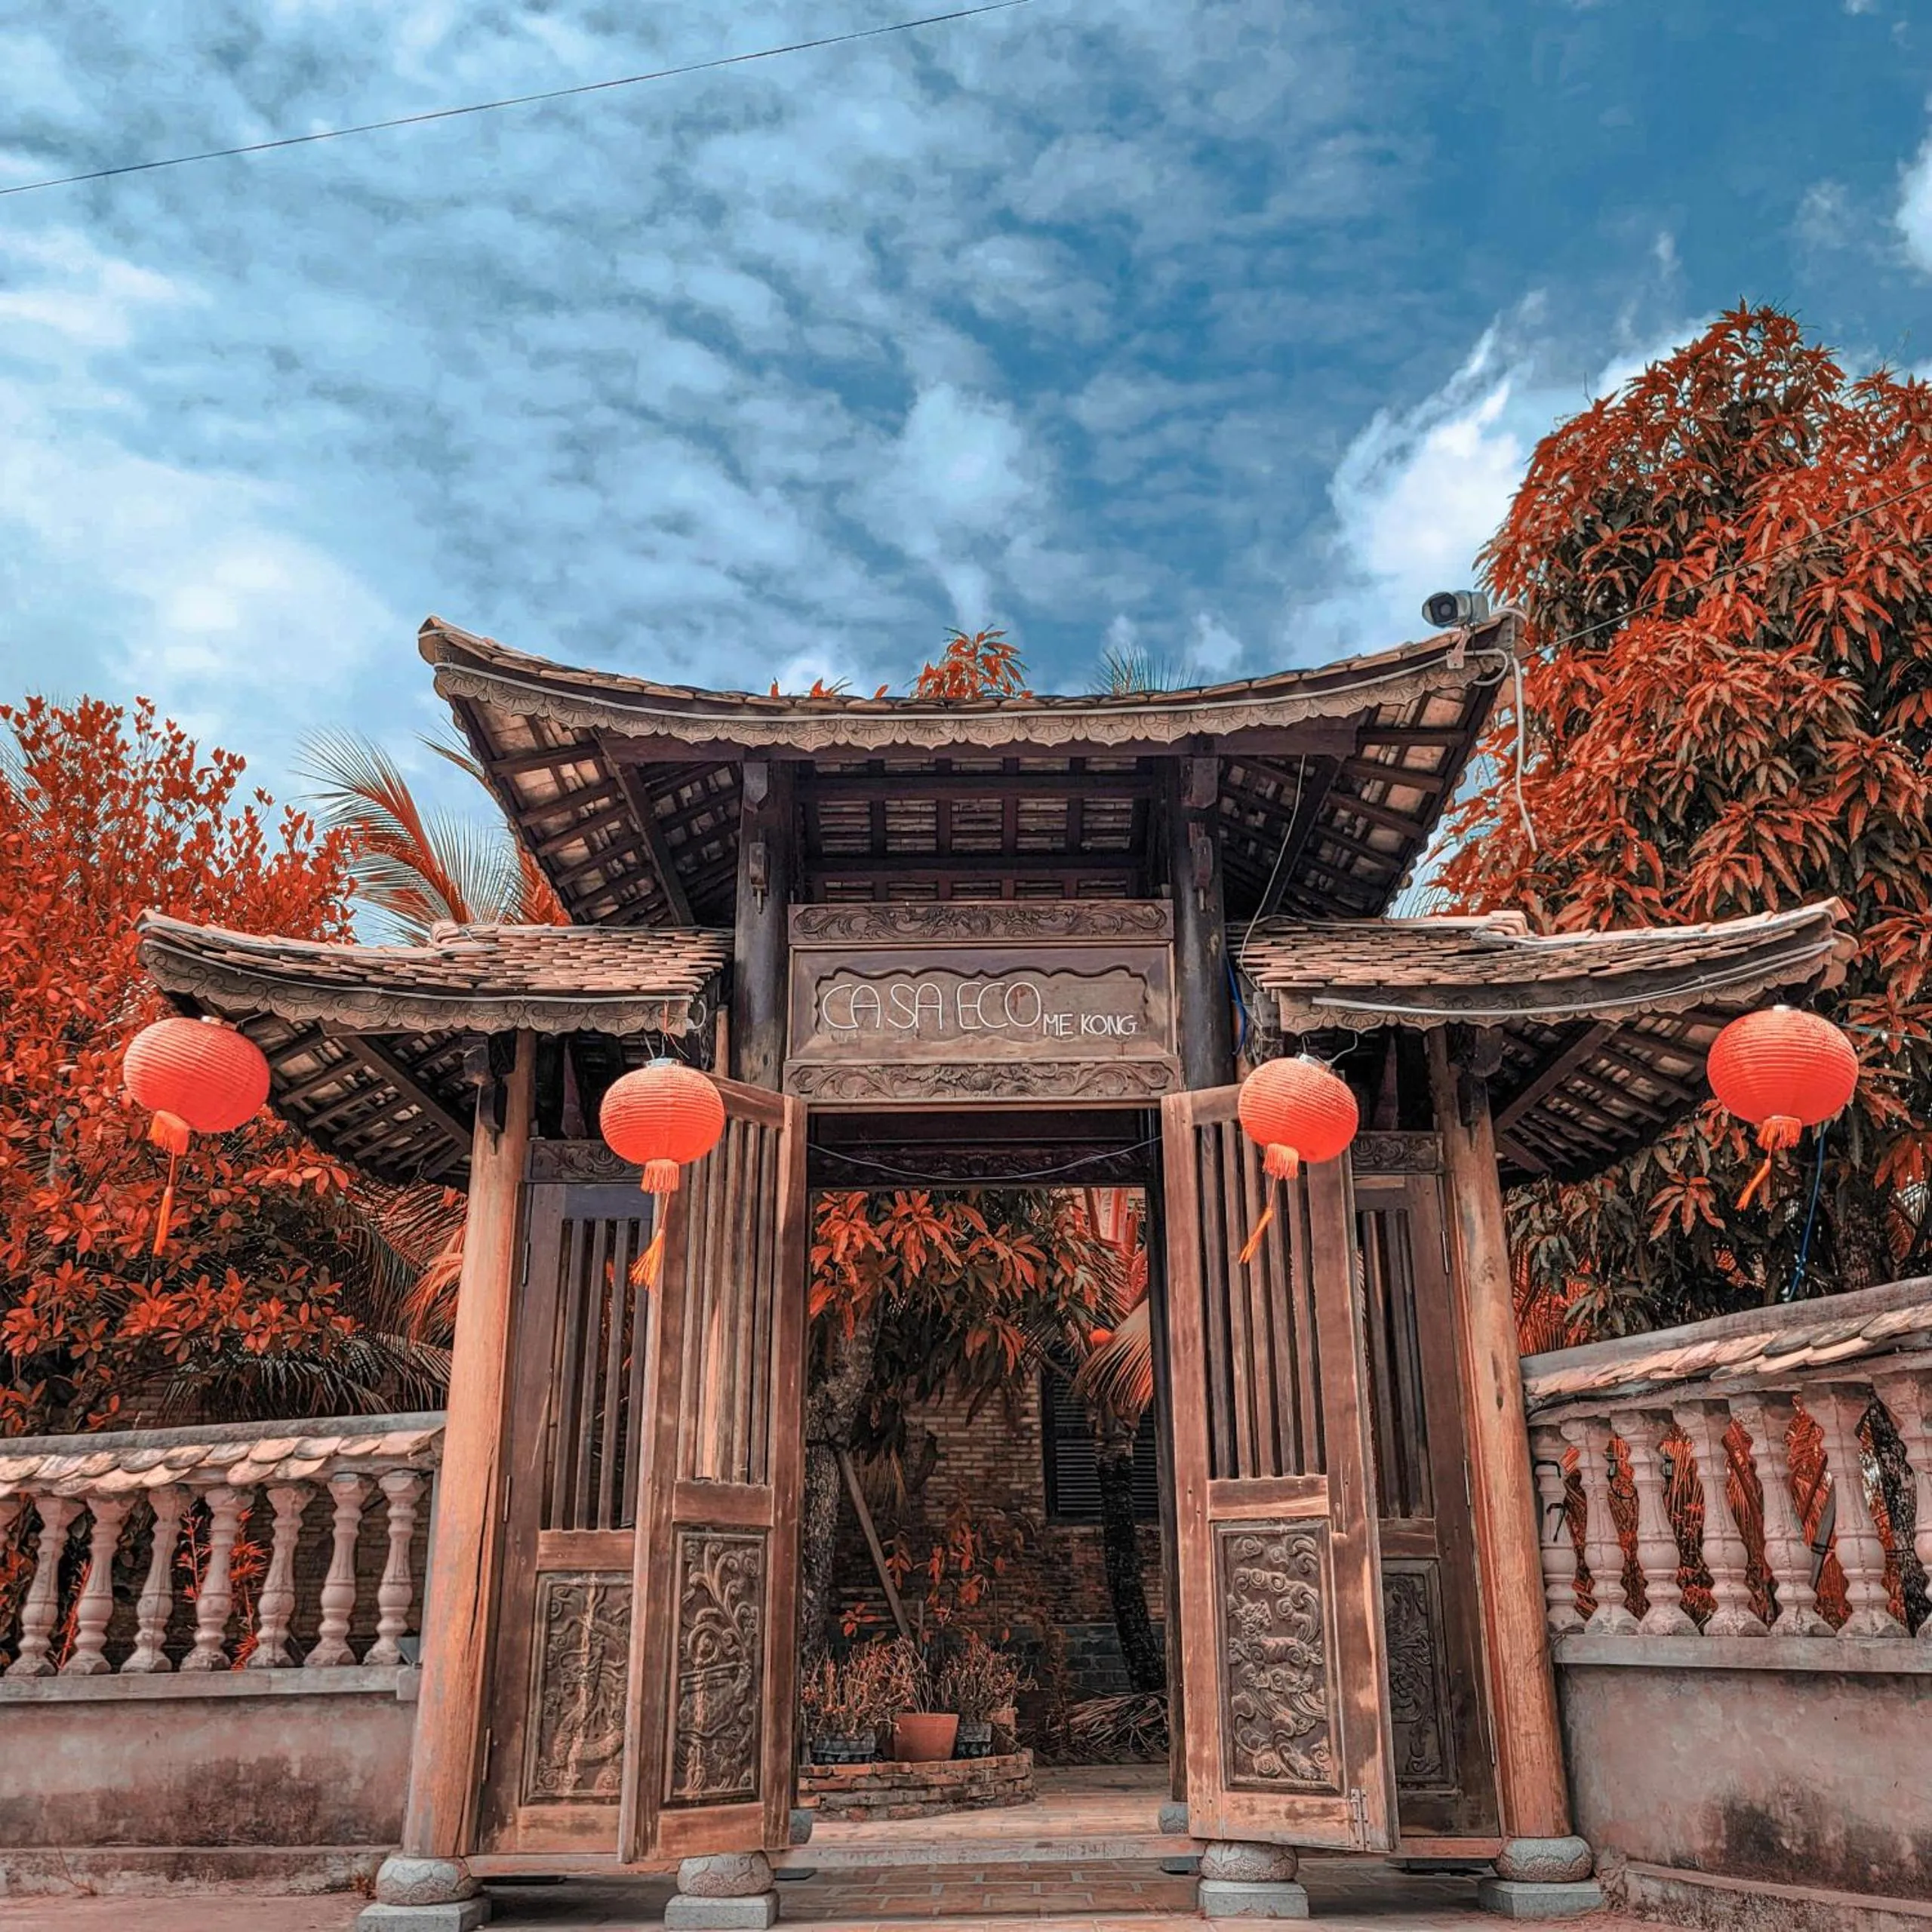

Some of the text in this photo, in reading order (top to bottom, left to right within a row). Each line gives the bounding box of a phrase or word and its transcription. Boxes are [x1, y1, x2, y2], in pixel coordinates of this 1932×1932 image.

[823, 982, 1137, 1036] CASA ECO ME KONG
